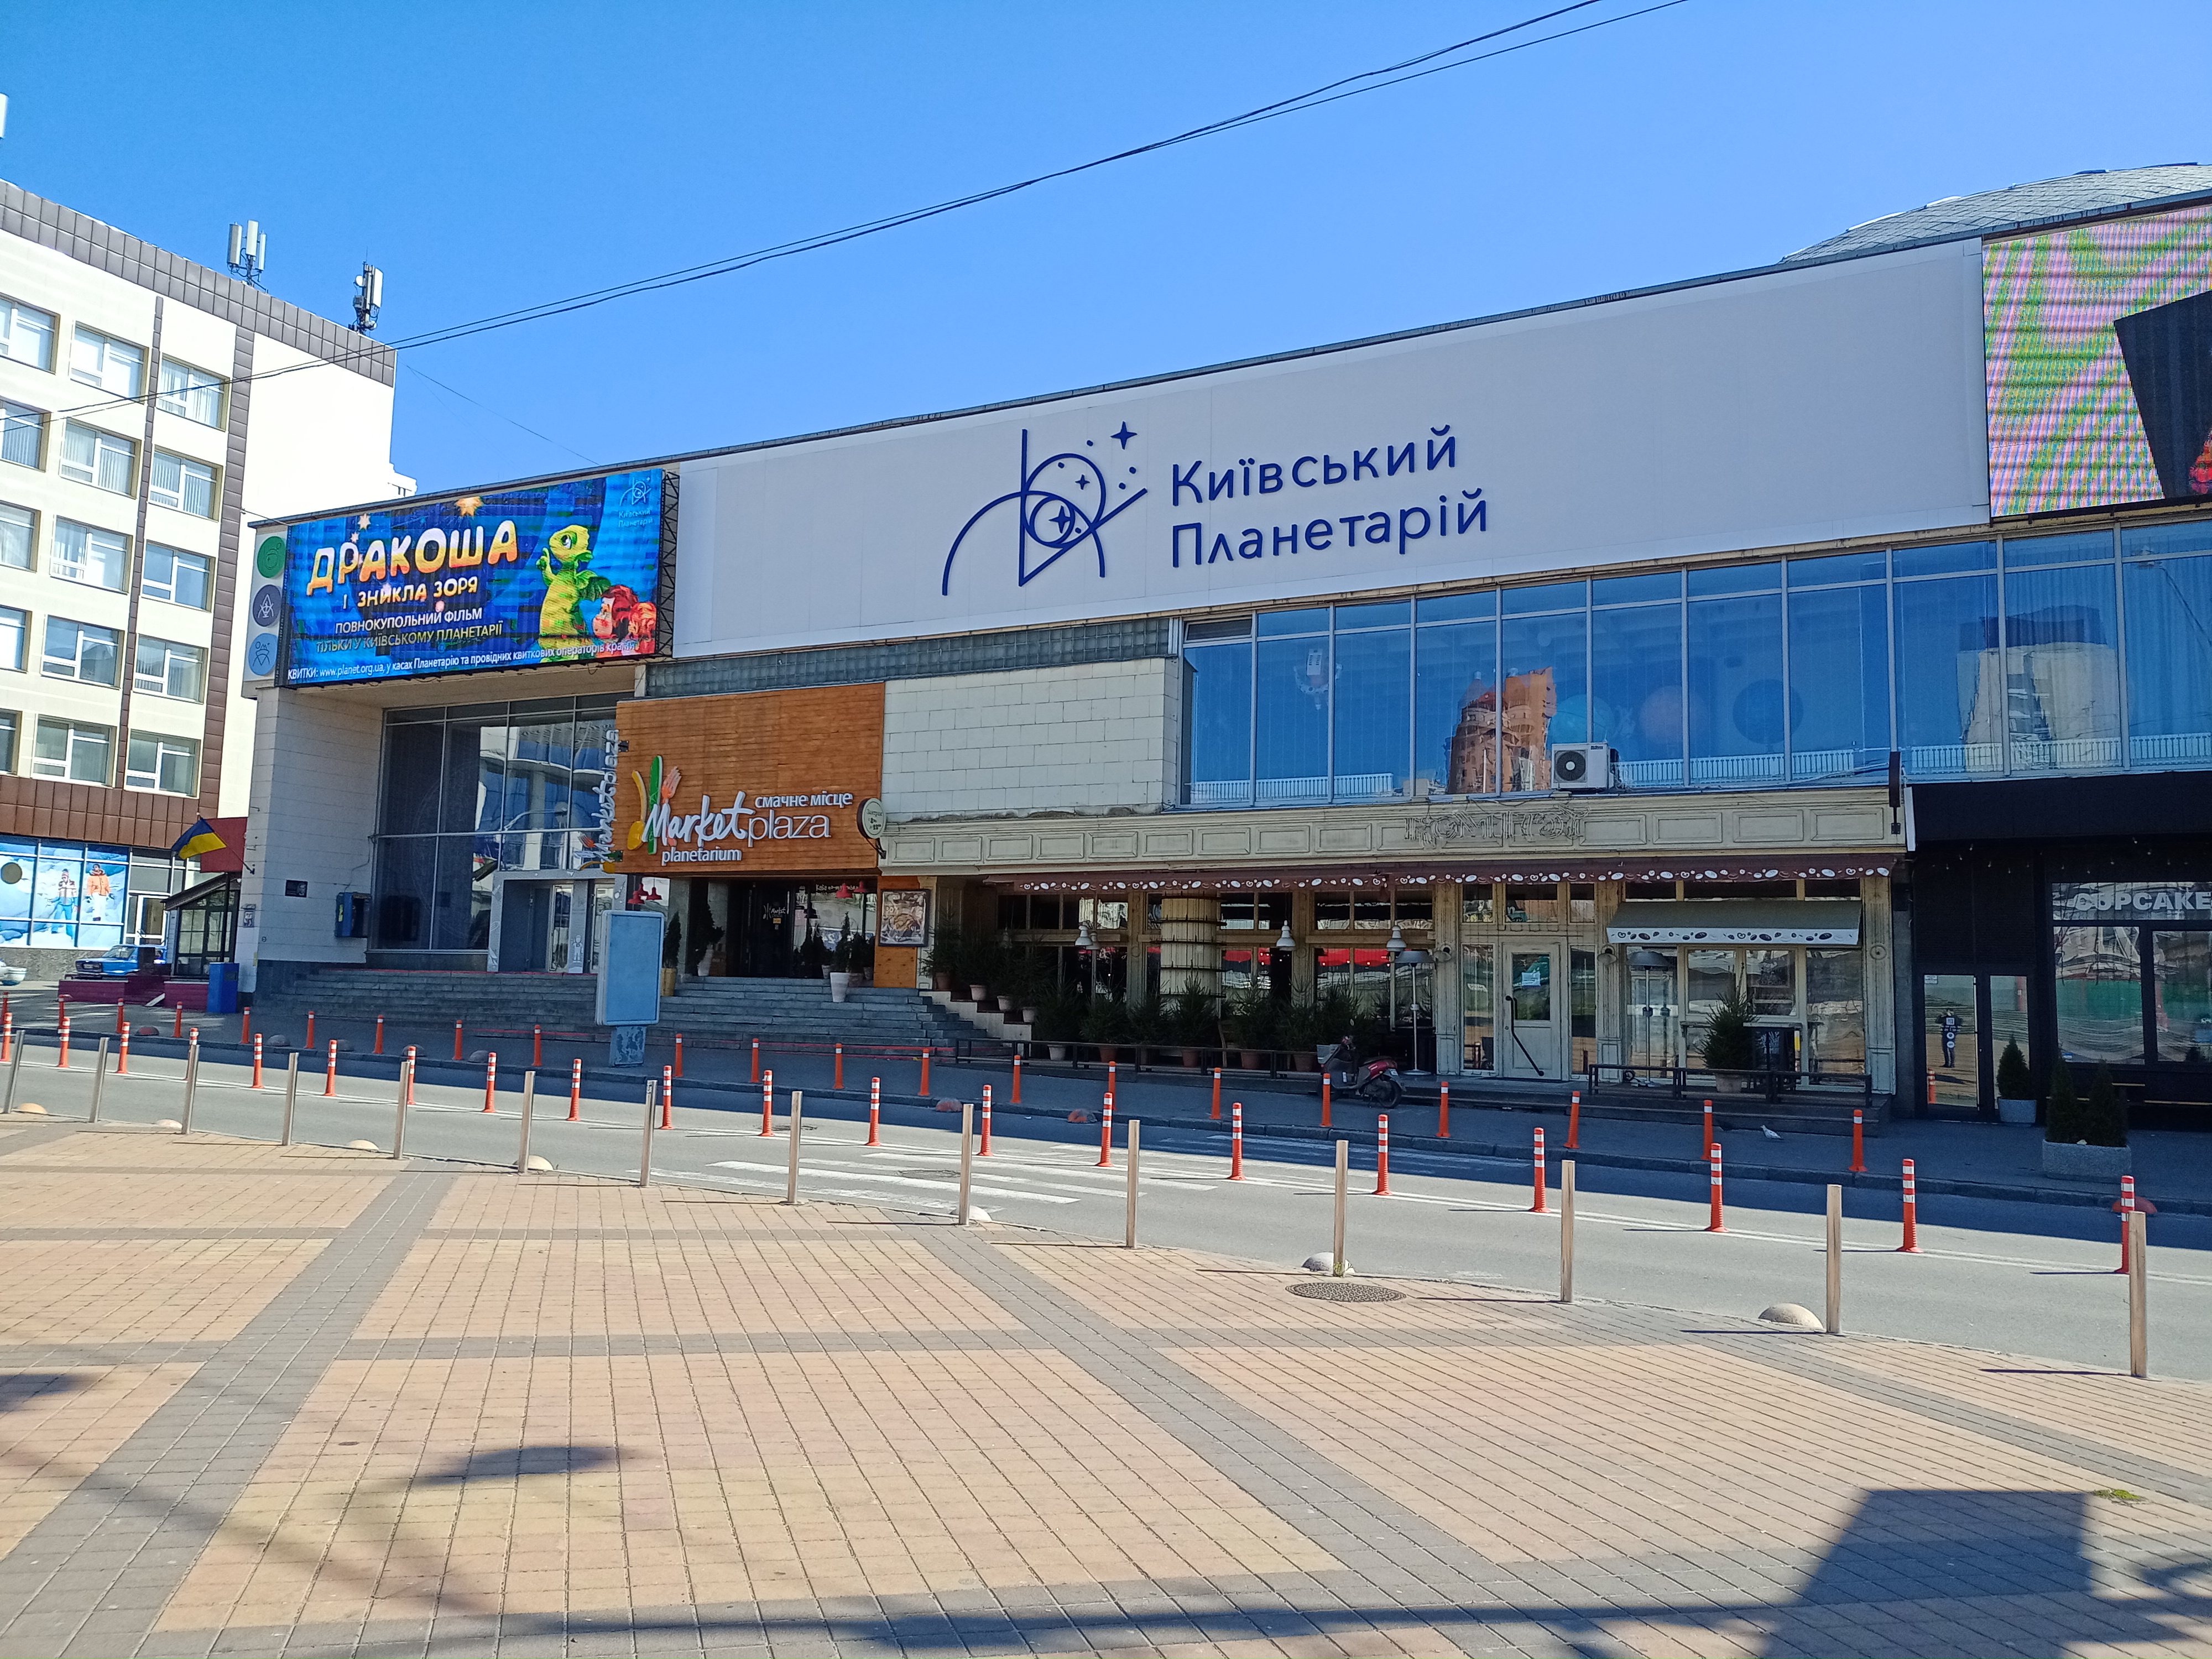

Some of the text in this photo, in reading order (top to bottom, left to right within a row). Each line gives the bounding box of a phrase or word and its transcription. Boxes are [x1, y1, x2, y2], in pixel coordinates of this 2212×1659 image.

[1172, 424, 1455, 506] Київський
[1172, 488, 1486, 568] Планетарій
[306, 520, 518, 596] ДРАКОША
[357, 584, 427, 607] ЗНИКЛА
[433, 576, 478, 597] ЗОРЯ
[316, 639, 352, 653] ТІЛЬКИ
[364, 630, 434, 648] КИЇВСЬКОМУ
[436, 620, 503, 640] ПЛАНЕТАРІЇ
[335, 607, 482, 634] ПОВНОКУПОЛЬНИЙ ФІЛЬМ
[288, 667, 319, 680] КВИТКИ:
[392, 660, 413, 670] касах
[414, 656, 460, 669] Планетарію
[461, 656, 469, 664] та
[471, 651, 512, 666] провідних
[513, 649, 555, 660] квиткових
[556, 642, 604, 658] операторів
[755, 791, 853, 809] смачне місце
[641, 791, 831, 848] Market plaza
[661, 846, 742, 867] planetarium
